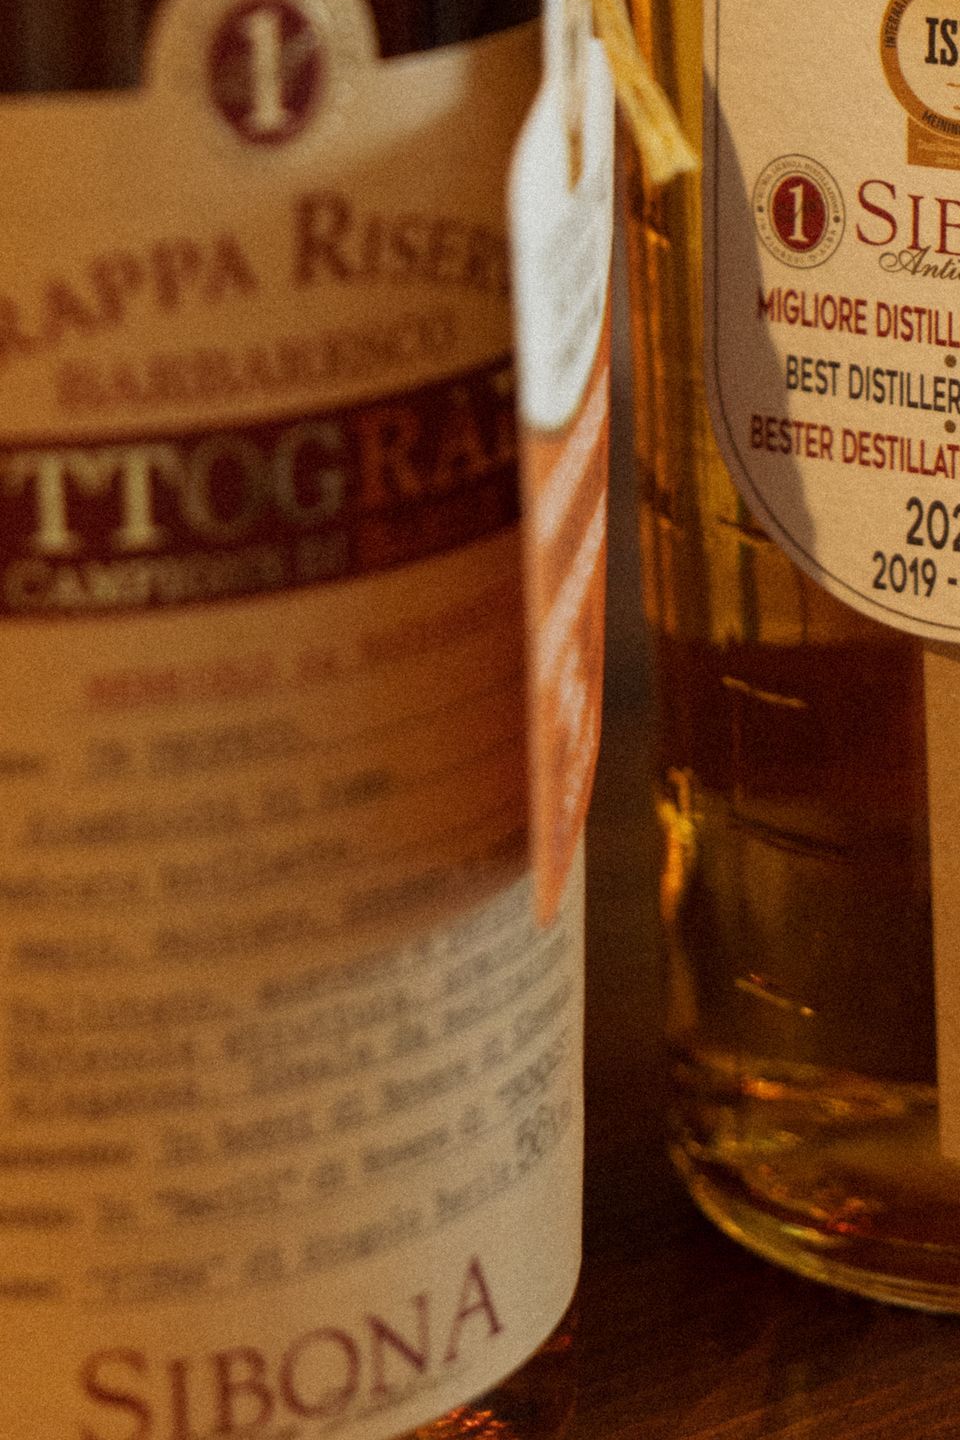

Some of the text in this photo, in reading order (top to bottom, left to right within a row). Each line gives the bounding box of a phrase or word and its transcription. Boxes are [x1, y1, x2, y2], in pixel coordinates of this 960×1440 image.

[788, 183, 809, 244] 1
[757, 286, 868, 336] MIGLIORE
[785, 354, 841, 396] BEST
[750, 414, 835, 460] BESTER
[872, 551, 938, 598] 2019
[78, 1254, 504, 1440] SIBONA
